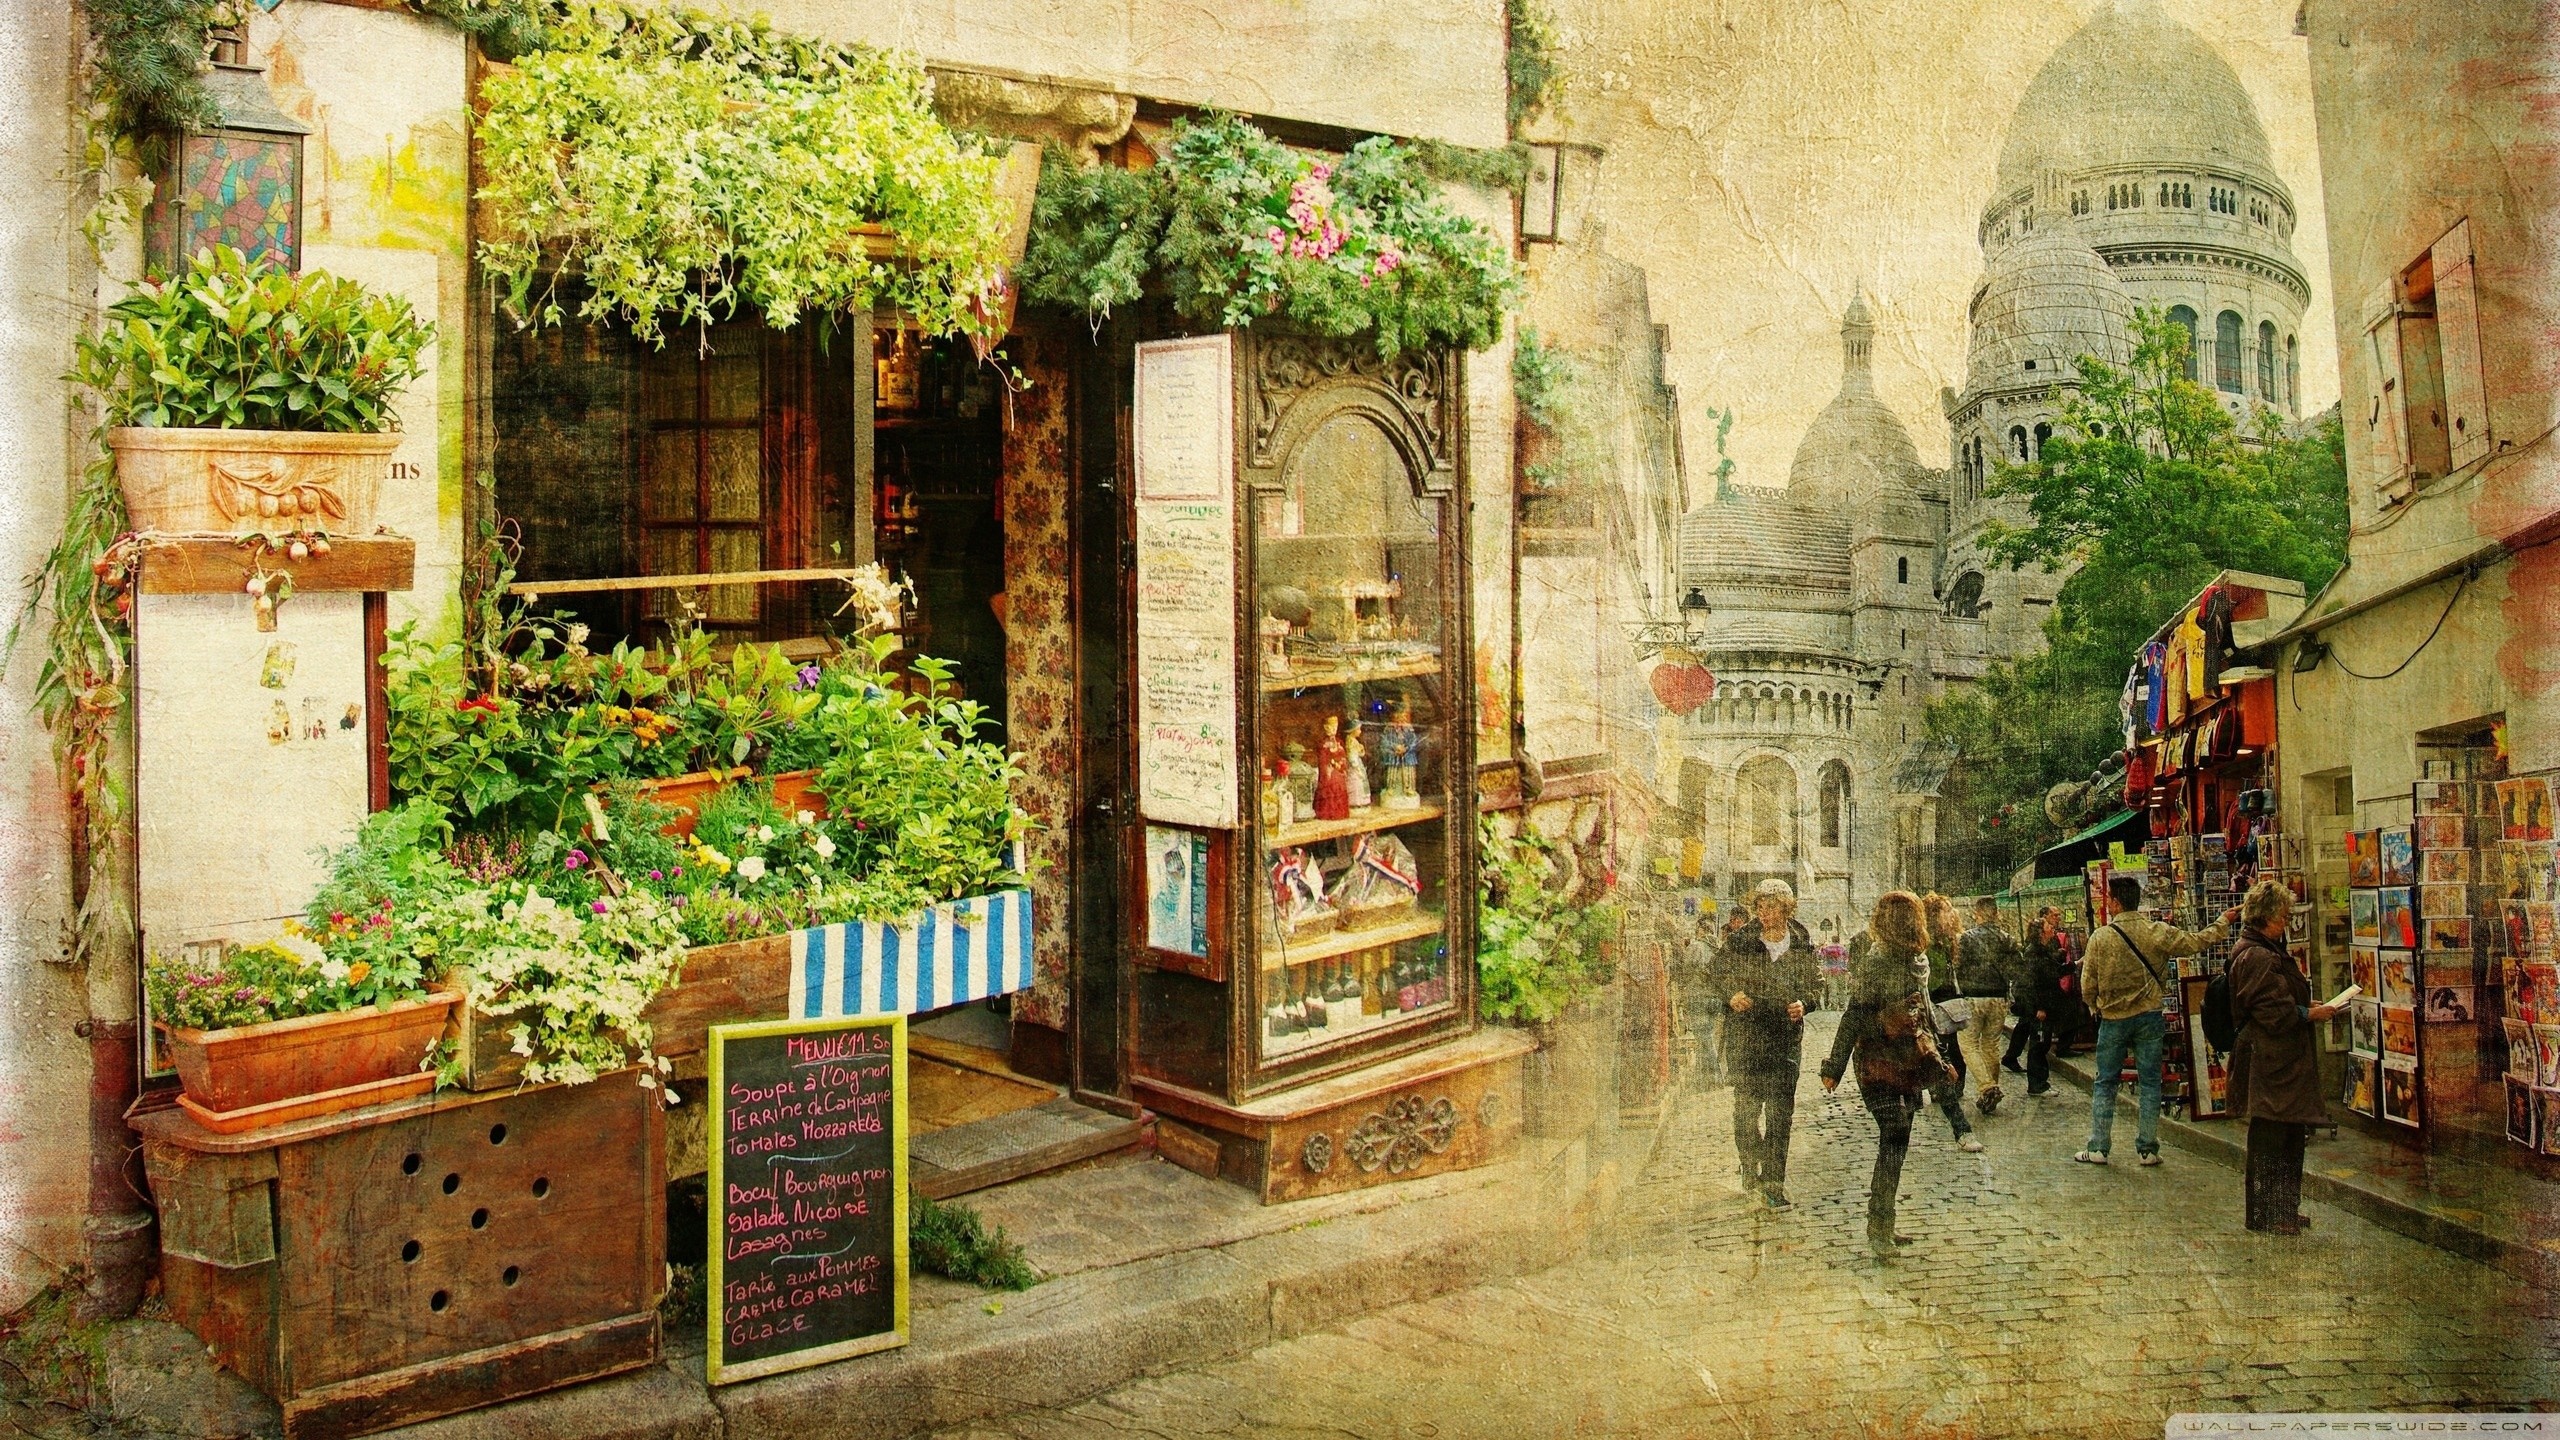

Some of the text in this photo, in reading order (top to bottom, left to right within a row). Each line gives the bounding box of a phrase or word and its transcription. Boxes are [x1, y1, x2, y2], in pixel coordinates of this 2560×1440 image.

[804, 1073, 817, 1091] à
[808, 1093, 824, 1116] de
[728, 1203, 789, 1233] Salade
[728, 1227, 827, 1260] Lasagnes
[786, 1272, 817, 1286] aux
